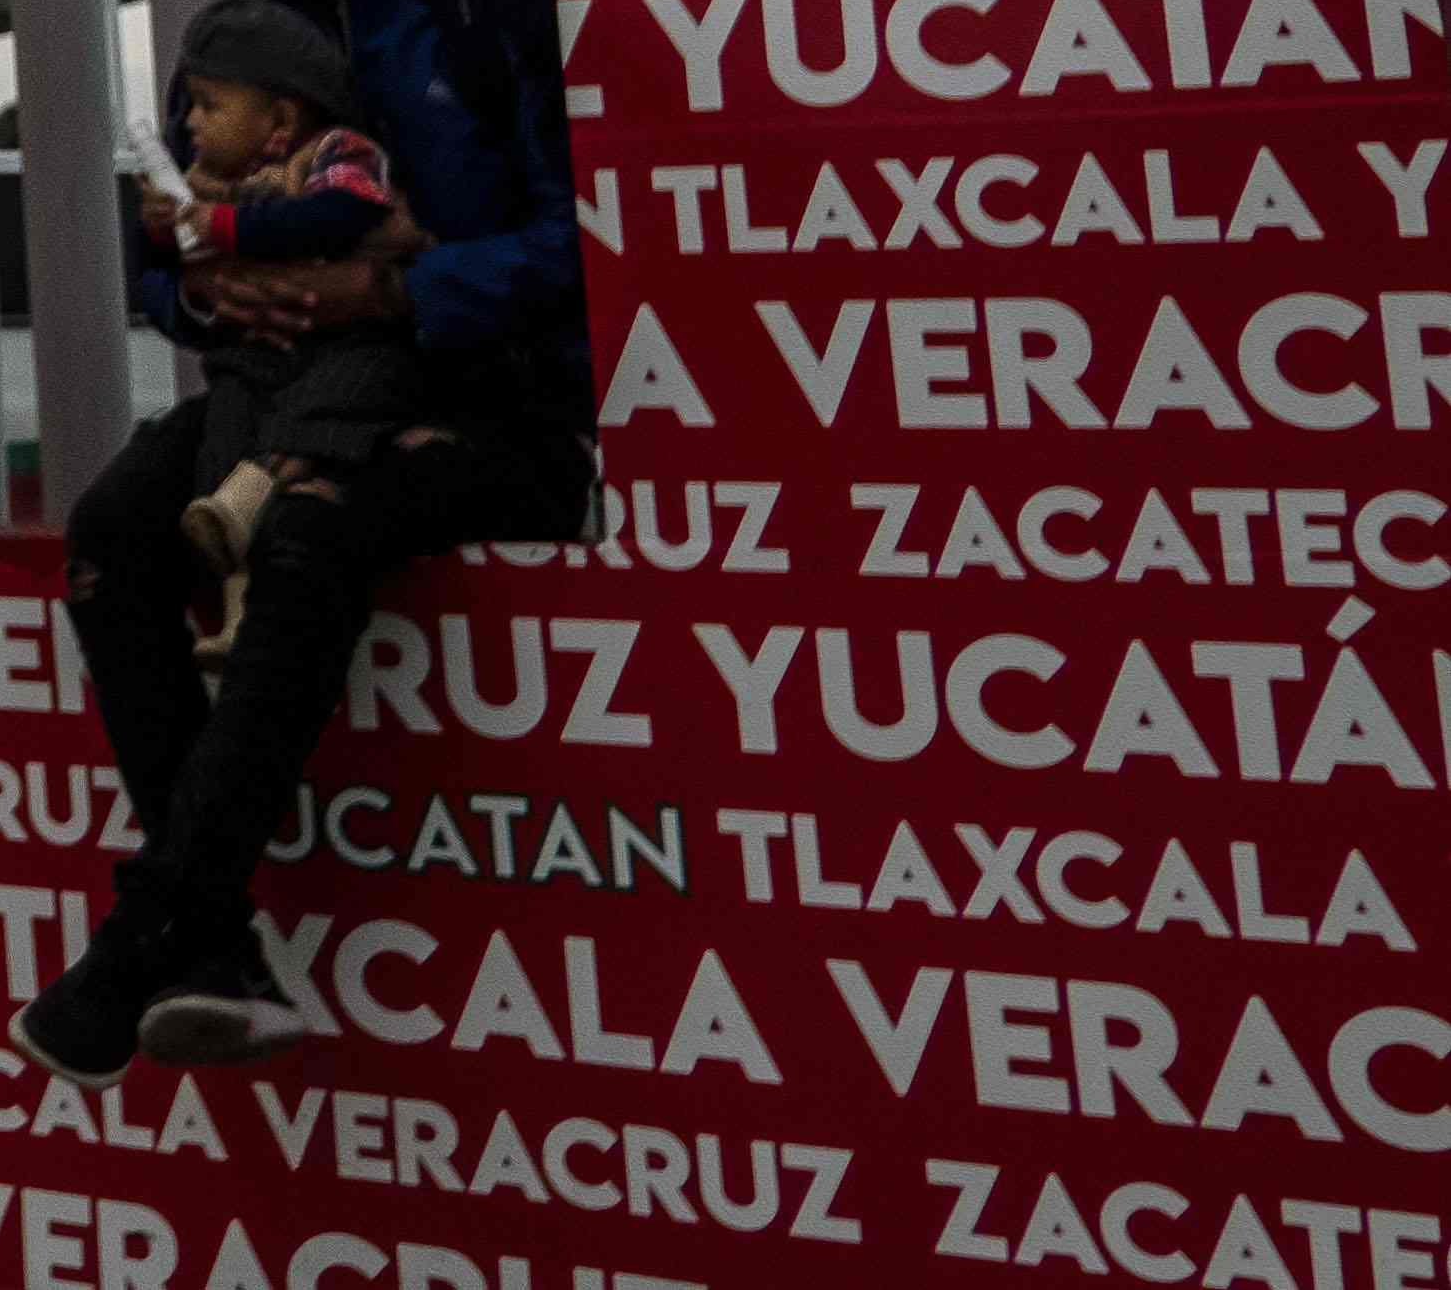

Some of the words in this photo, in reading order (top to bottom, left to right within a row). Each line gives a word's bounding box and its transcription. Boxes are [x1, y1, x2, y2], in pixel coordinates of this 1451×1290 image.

[652, 147, 1323, 253] TLAXCALA
[851, 484, 1451, 589] ZACATEC
[693, 596, 1451, 788] YUCATÁ
[717, 809, 1416, 951] TLAXCALA
[827, 959, 1451, 1151] VERAC
[254, 1083, 861, 1243] VERACRUZ
